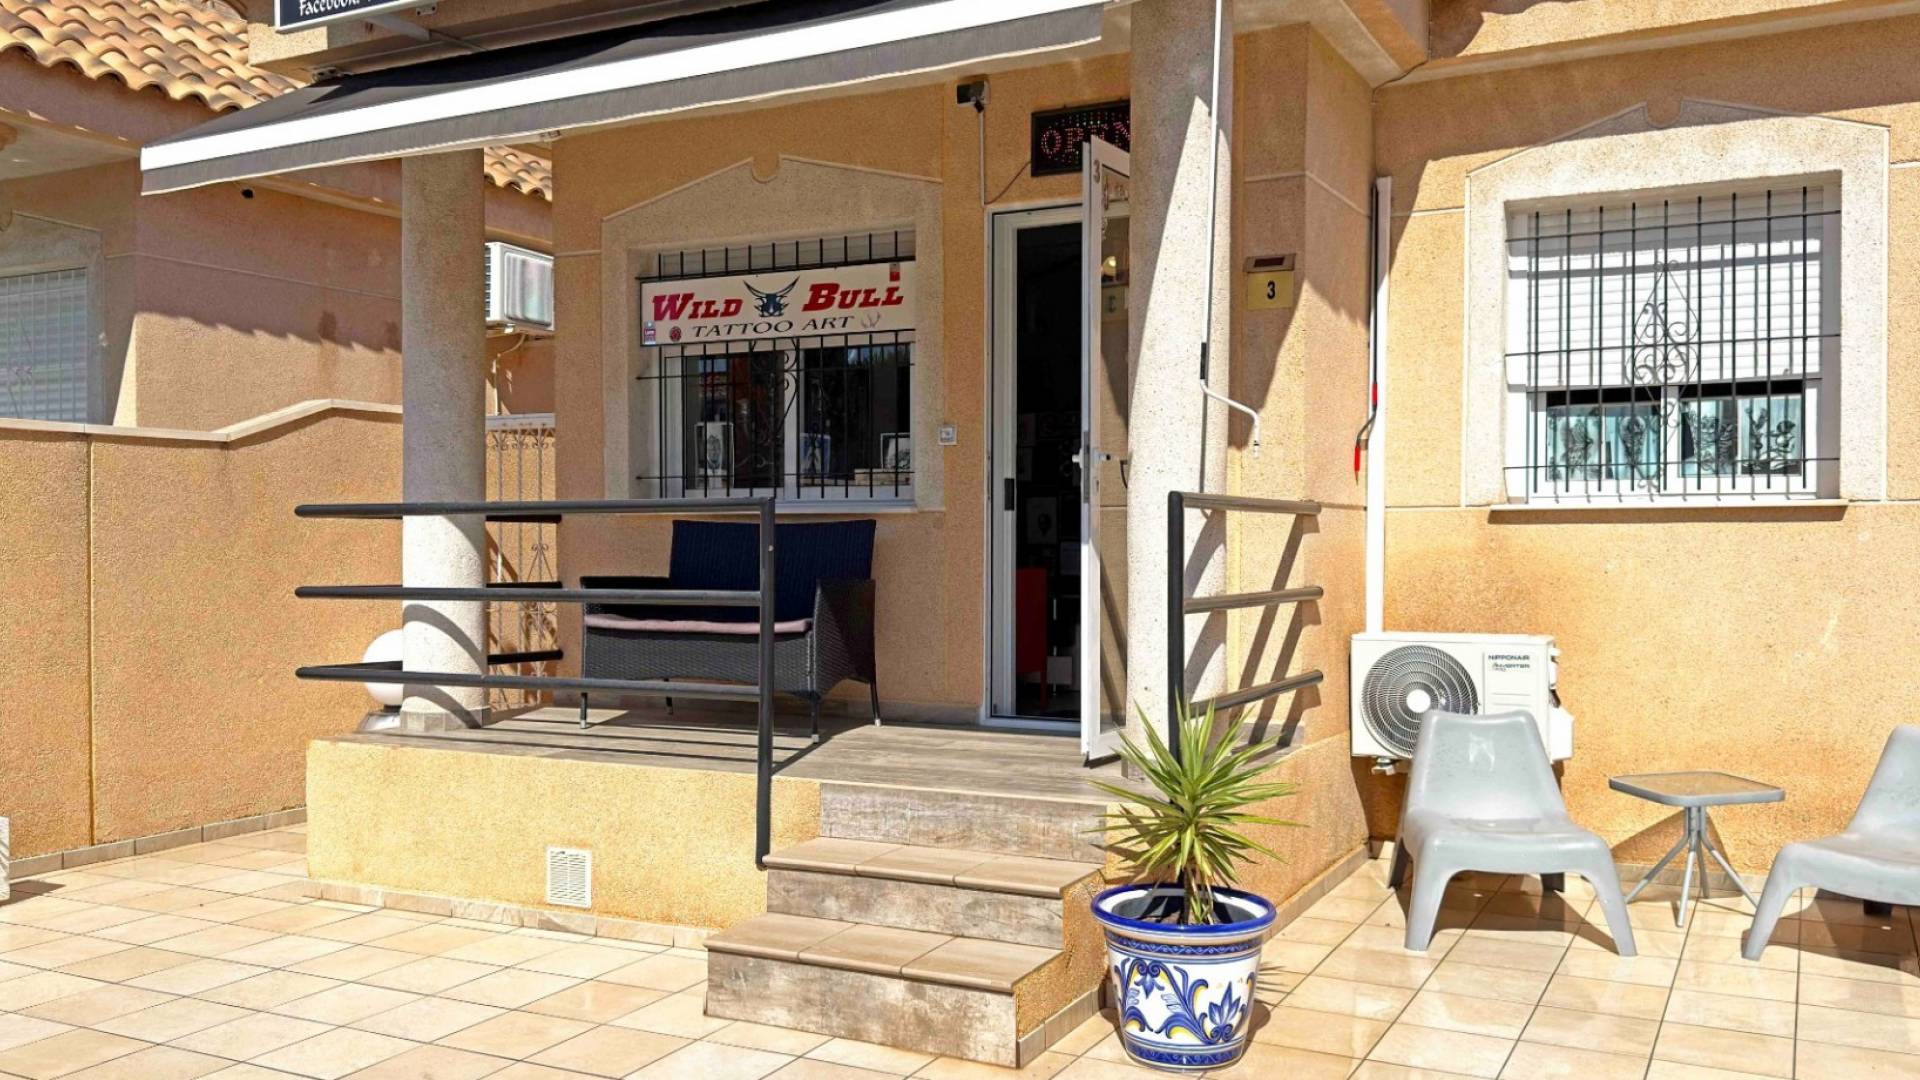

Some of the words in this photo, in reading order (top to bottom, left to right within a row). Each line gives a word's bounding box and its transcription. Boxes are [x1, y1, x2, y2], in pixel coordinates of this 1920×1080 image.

[1267, 280, 1276, 299] 3
[652, 292, 744, 321] WILD
[801, 282, 904, 312] BULL
[692, 321, 794, 338] TATTOO
[801, 315, 855, 331] ART
